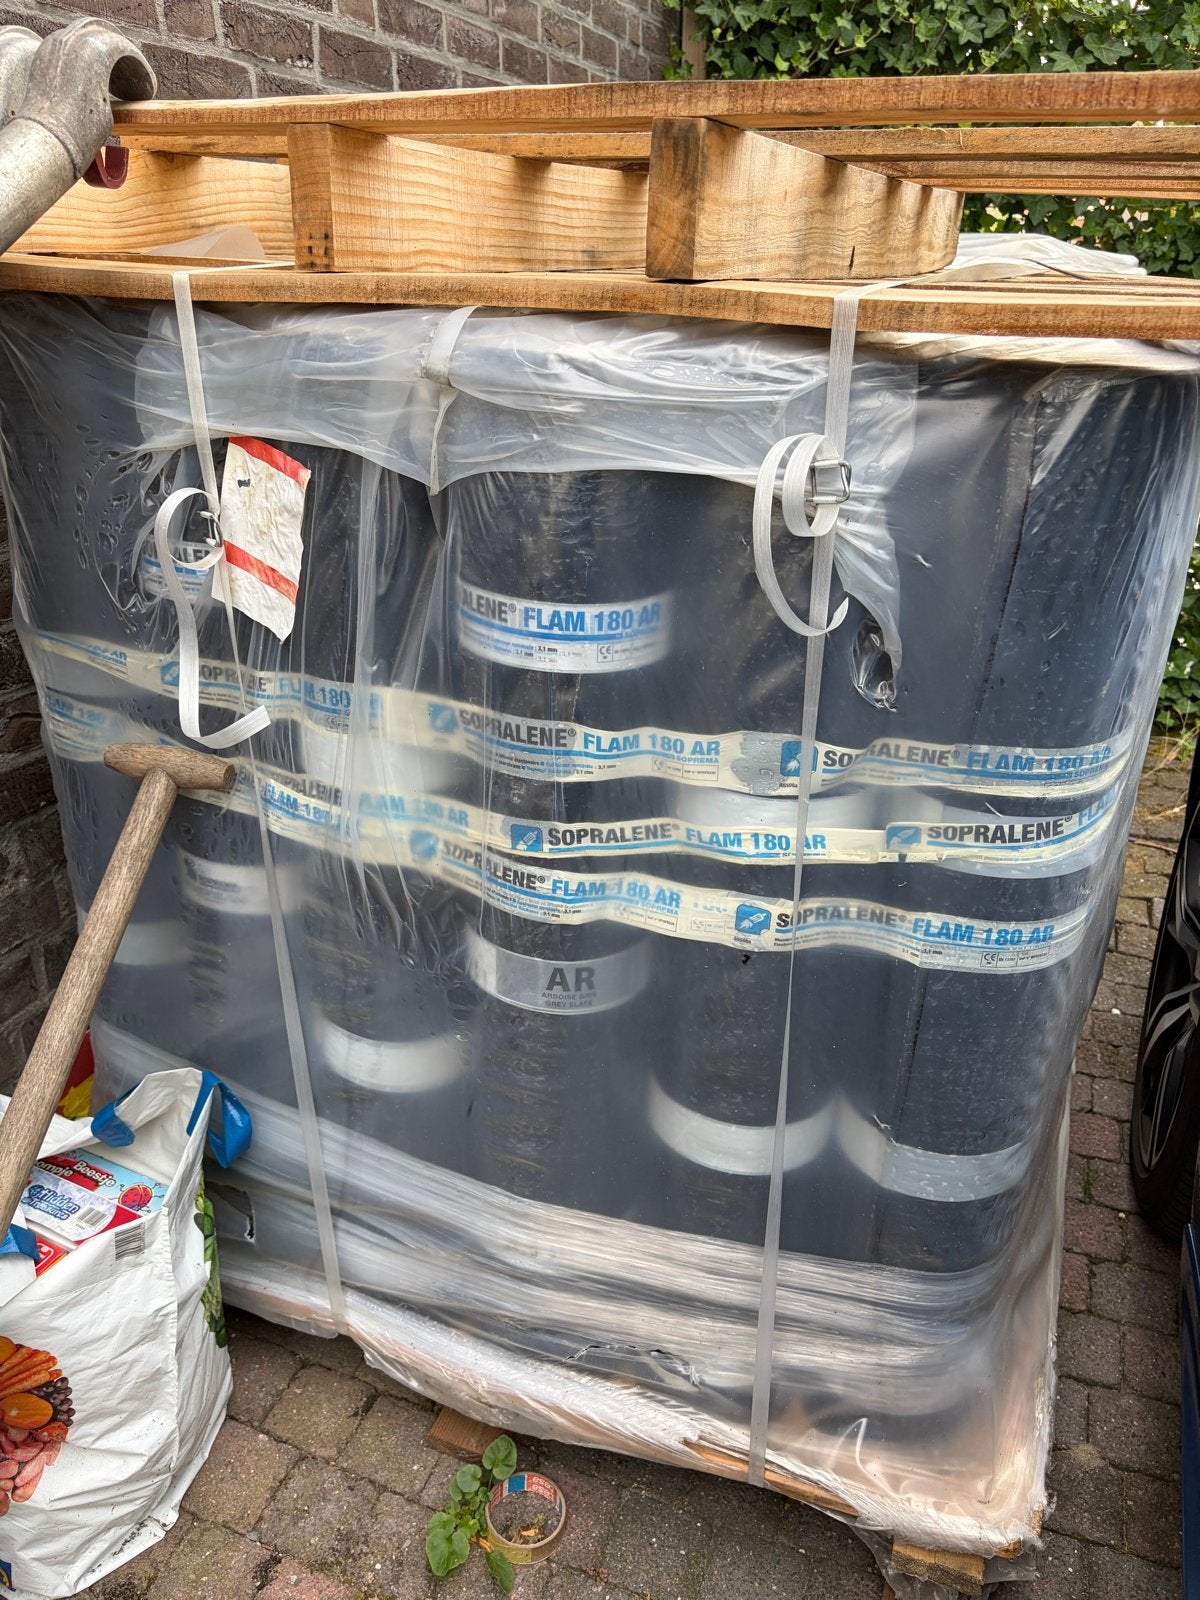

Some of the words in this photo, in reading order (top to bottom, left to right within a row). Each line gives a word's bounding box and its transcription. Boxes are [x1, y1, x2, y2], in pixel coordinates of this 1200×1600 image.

[523, 606, 586, 632] FLAM
[594, 610, 633, 632] 180
[583, 732, 640, 753] FLAM
[648, 734, 685, 755] 180
[690, 741, 720, 756] AR
[967, 751, 1035, 772] FLAM
[1045, 755, 1084, 771] 180
[547, 822, 680, 847] SOPRALENE®
[685, 827, 742, 848] FLAM
[750, 833, 791, 851] 180
[552, 878, 607, 897] FLAM
[655, 887, 681, 908] AR
[912, 917, 974, 943] FLAM
[982, 927, 1023, 946] 180
[545, 966, 596, 992] AR
[73, 1160, 116, 1187] Beestje
